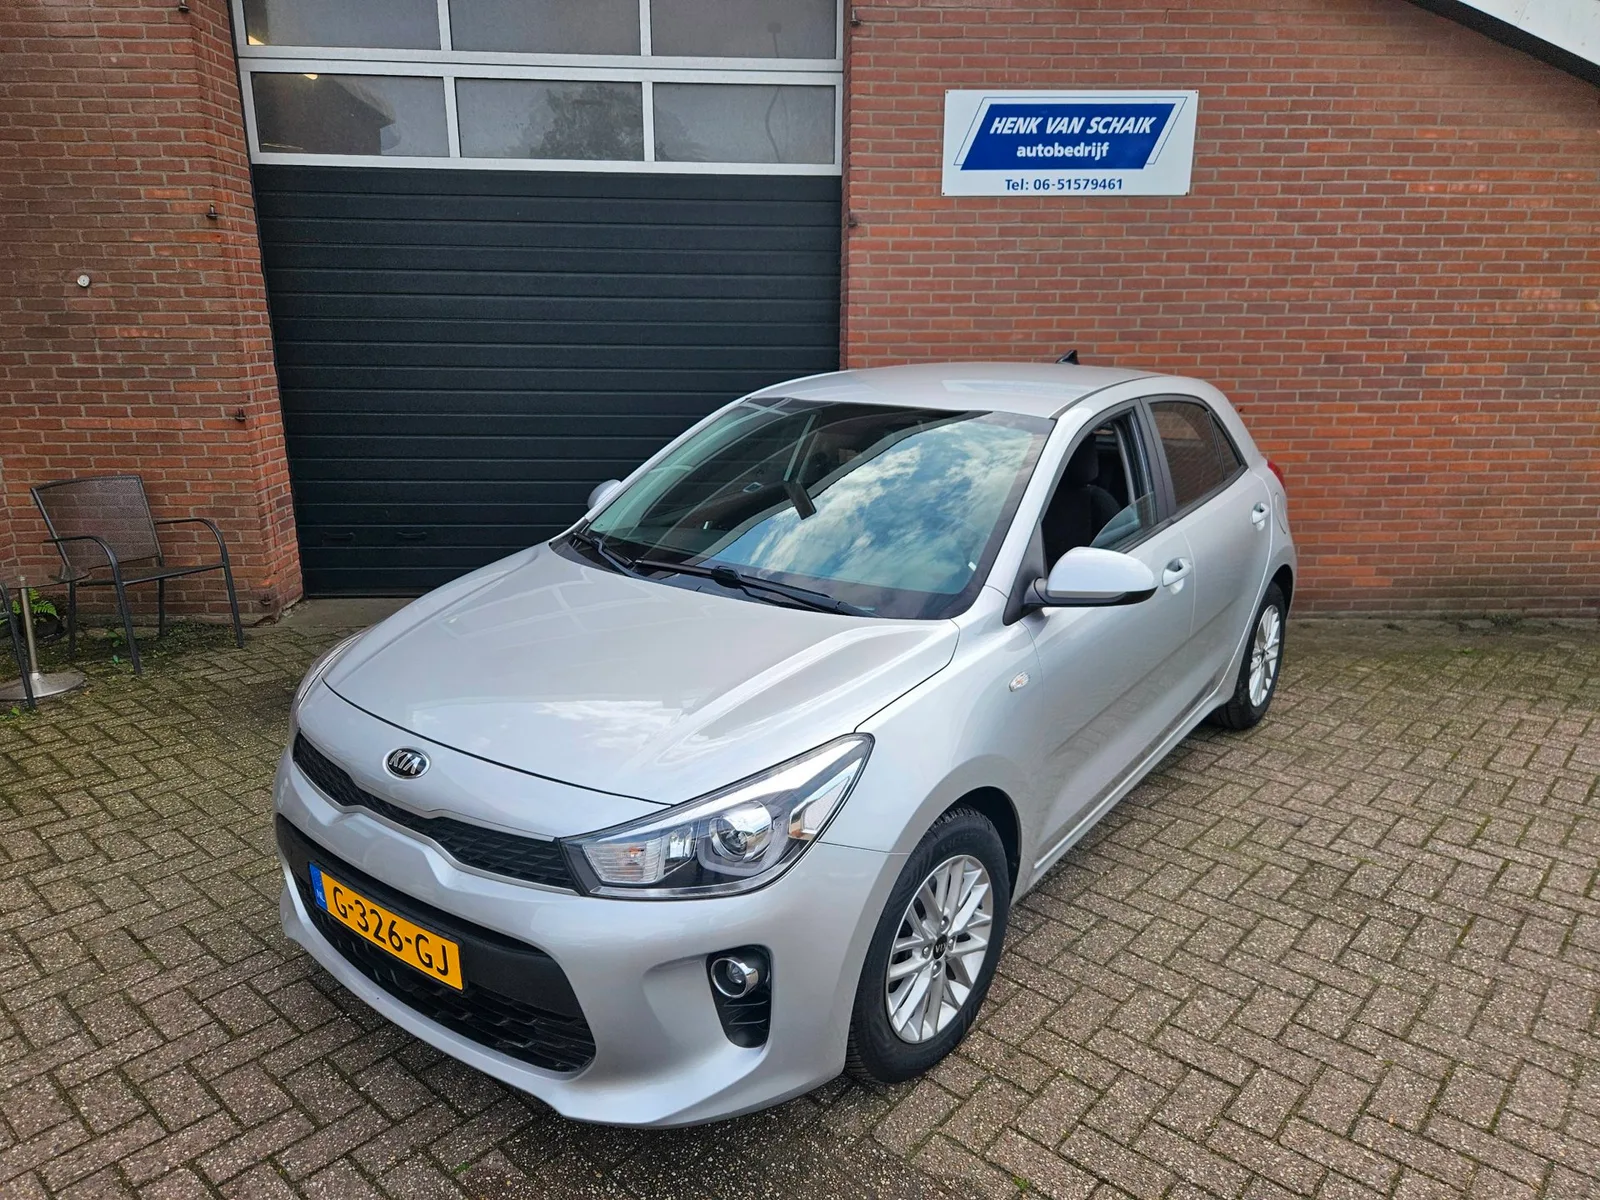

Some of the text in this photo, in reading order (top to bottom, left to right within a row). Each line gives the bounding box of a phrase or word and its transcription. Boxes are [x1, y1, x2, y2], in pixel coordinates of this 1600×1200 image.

[989, 116, 1157, 134] HENK VAN SCHAIK
[1016, 142, 1110, 161] autobedrijf
[1005, 178, 1123, 191] Tel: 06-51579461
[389, 750, 421, 775] KIA
[316, 889, 326, 903] NL
[333, 886, 449, 976] G-326-GJ
